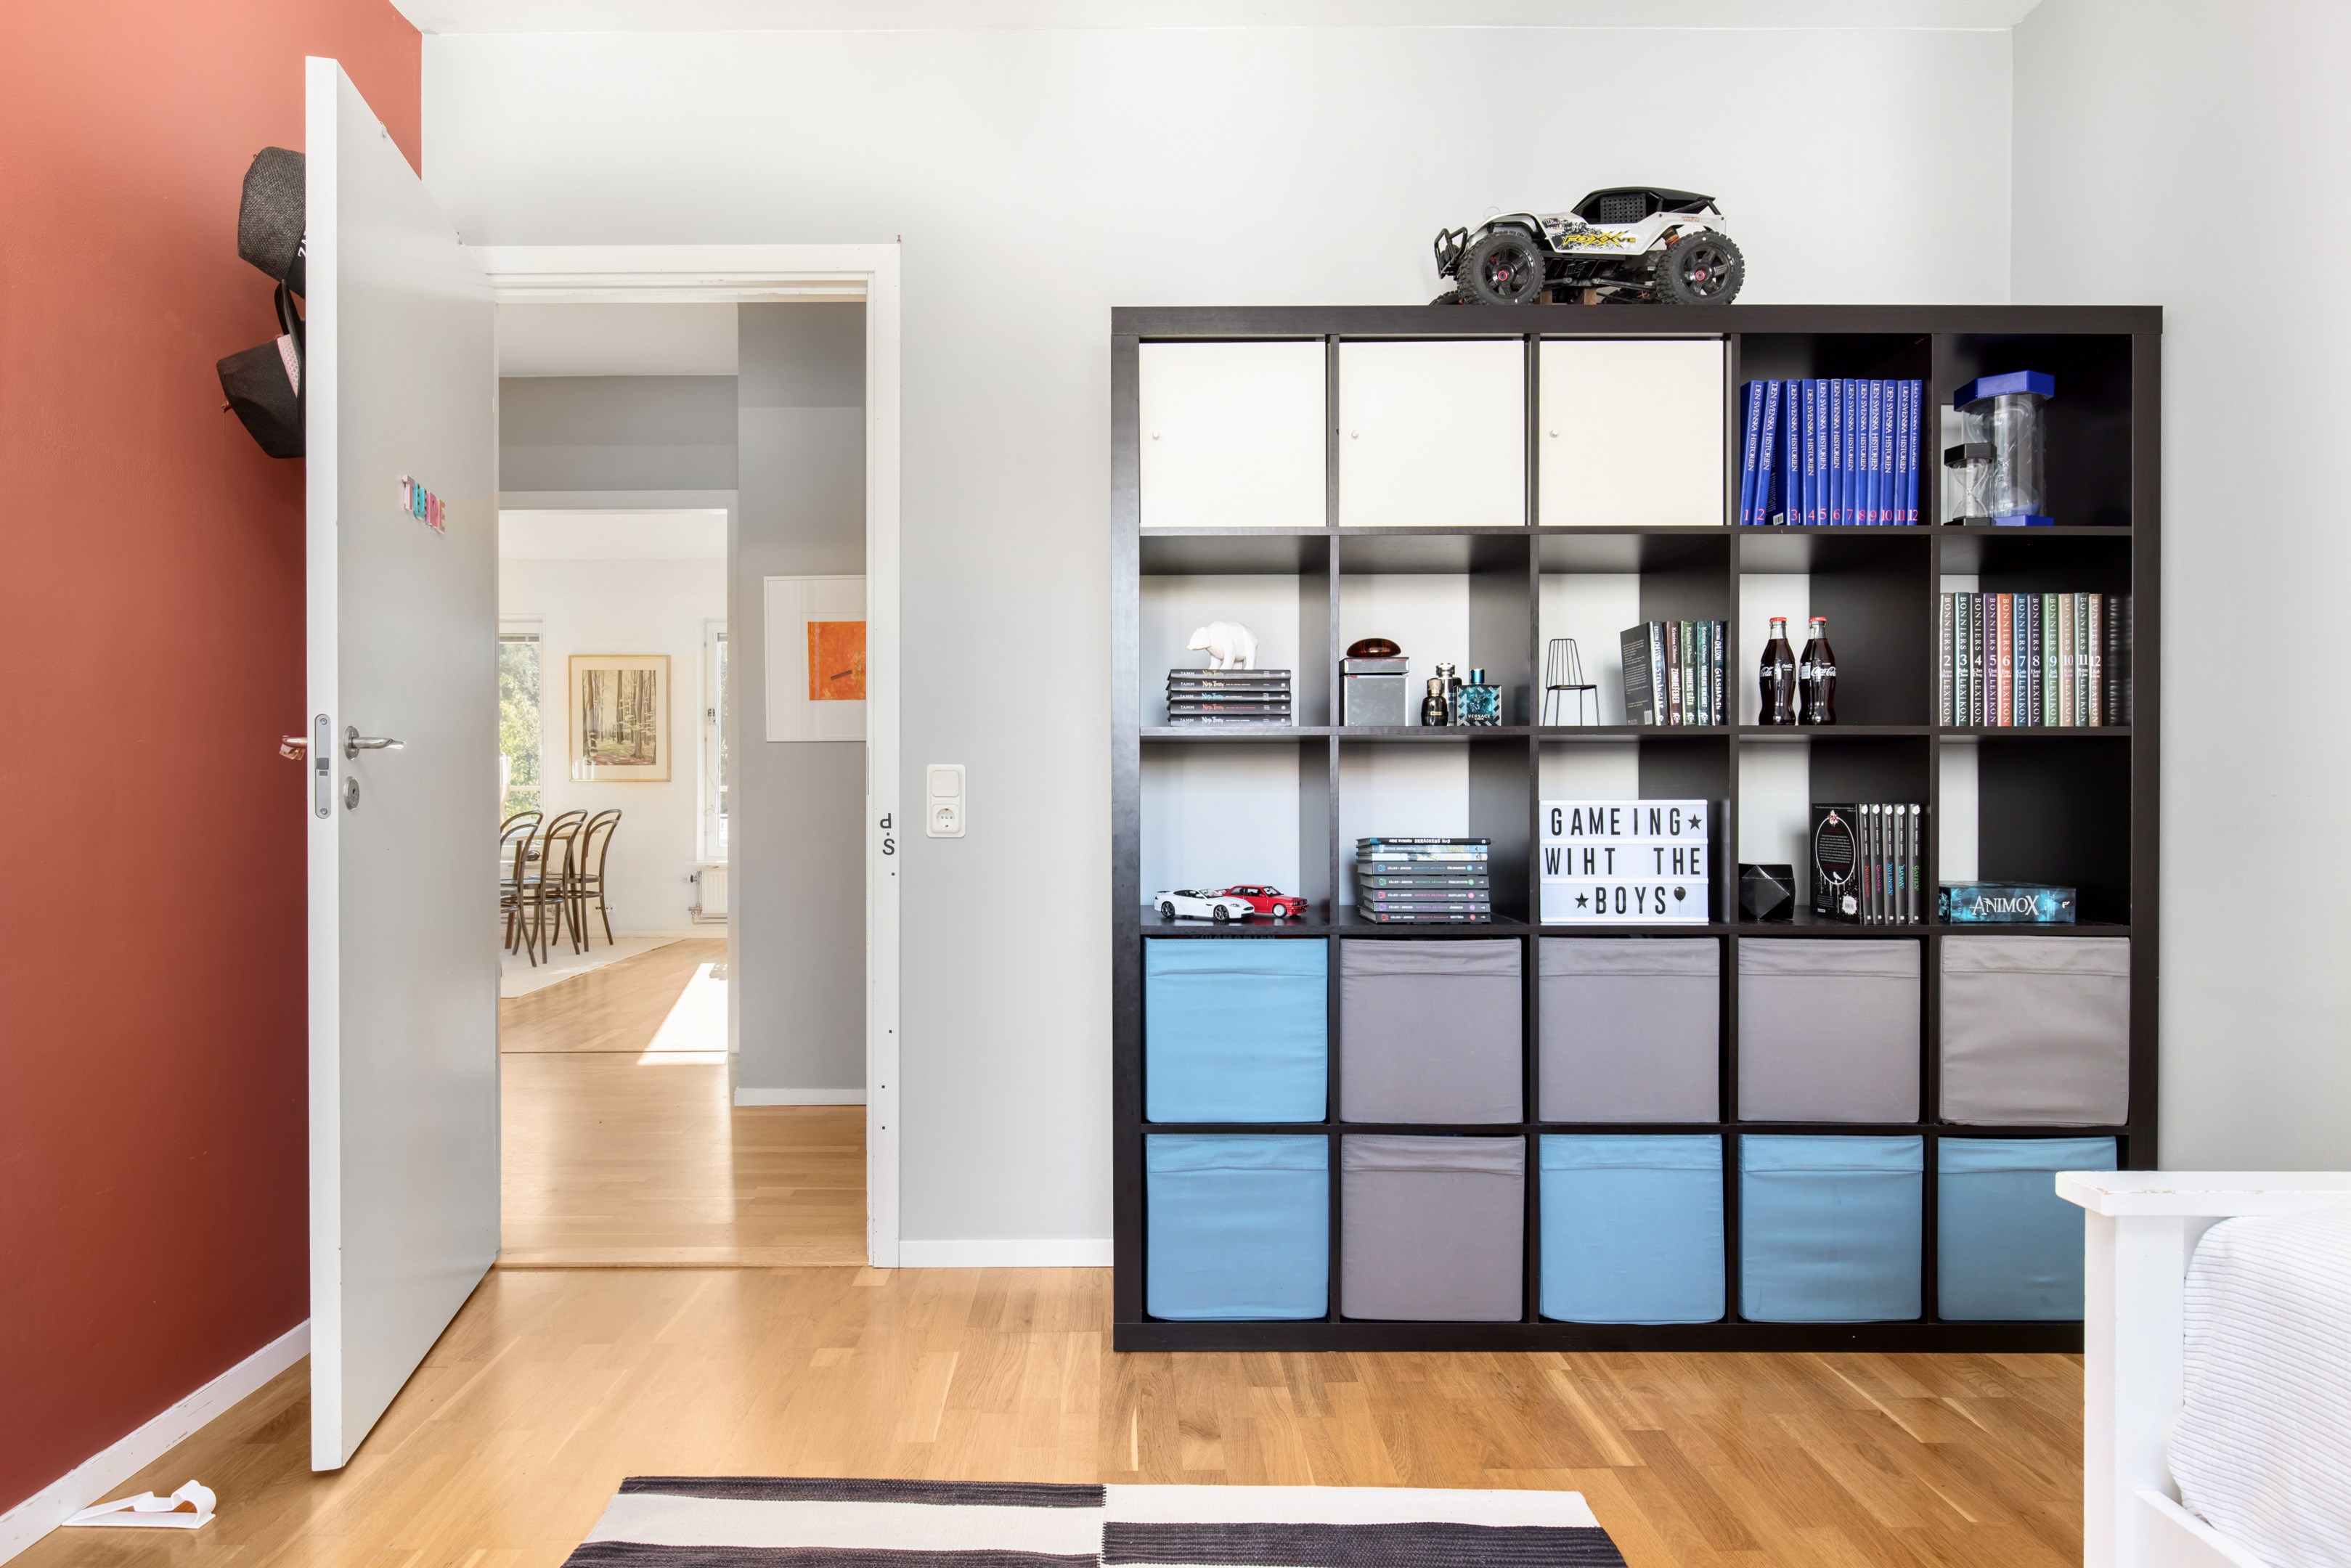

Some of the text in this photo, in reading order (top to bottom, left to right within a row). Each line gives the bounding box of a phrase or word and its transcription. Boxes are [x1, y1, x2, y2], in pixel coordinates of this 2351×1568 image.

[1767, 401, 1776, 430] SVENSKA
[1744, 510, 1749, 520] 1
[1757, 510, 1764, 520] 2
[1790, 510, 1798, 520] 3
[1809, 510, 1814, 520] 4
[1820, 509, 1827, 520] 5
[1833, 509, 1841, 520] 6
[1846, 510, 1853, 520] 7
[1859, 510, 1865, 520] 8
[1870, 510, 1877, 520] 9
[1882, 510, 1892, 520] 10
[1896, 510, 1905, 520] 11
[1909, 510, 1918, 520] 12
[1944, 656, 1951, 666] 2
[1960, 655, 1967, 666] 3
[1975, 656, 1982, 666] 4
[1990, 656, 1996, 666] 5
[2003, 656, 2010, 666] 6
[2019, 656, 2026, 666] 7
[2033, 656, 2040, 666] 8
[2050, 656, 2057, 666] 9
[2063, 656, 2074, 666] 10
[2079, 655, 2087, 666] 11
[2090, 656, 2101, 666] 12
[1551, 807, 1681, 836] GAMEING
[1545, 847, 1700, 875] WIHT THE
[1596, 886, 1666, 915] BOYS
[1969, 895, 2039, 915] ANIMOX
